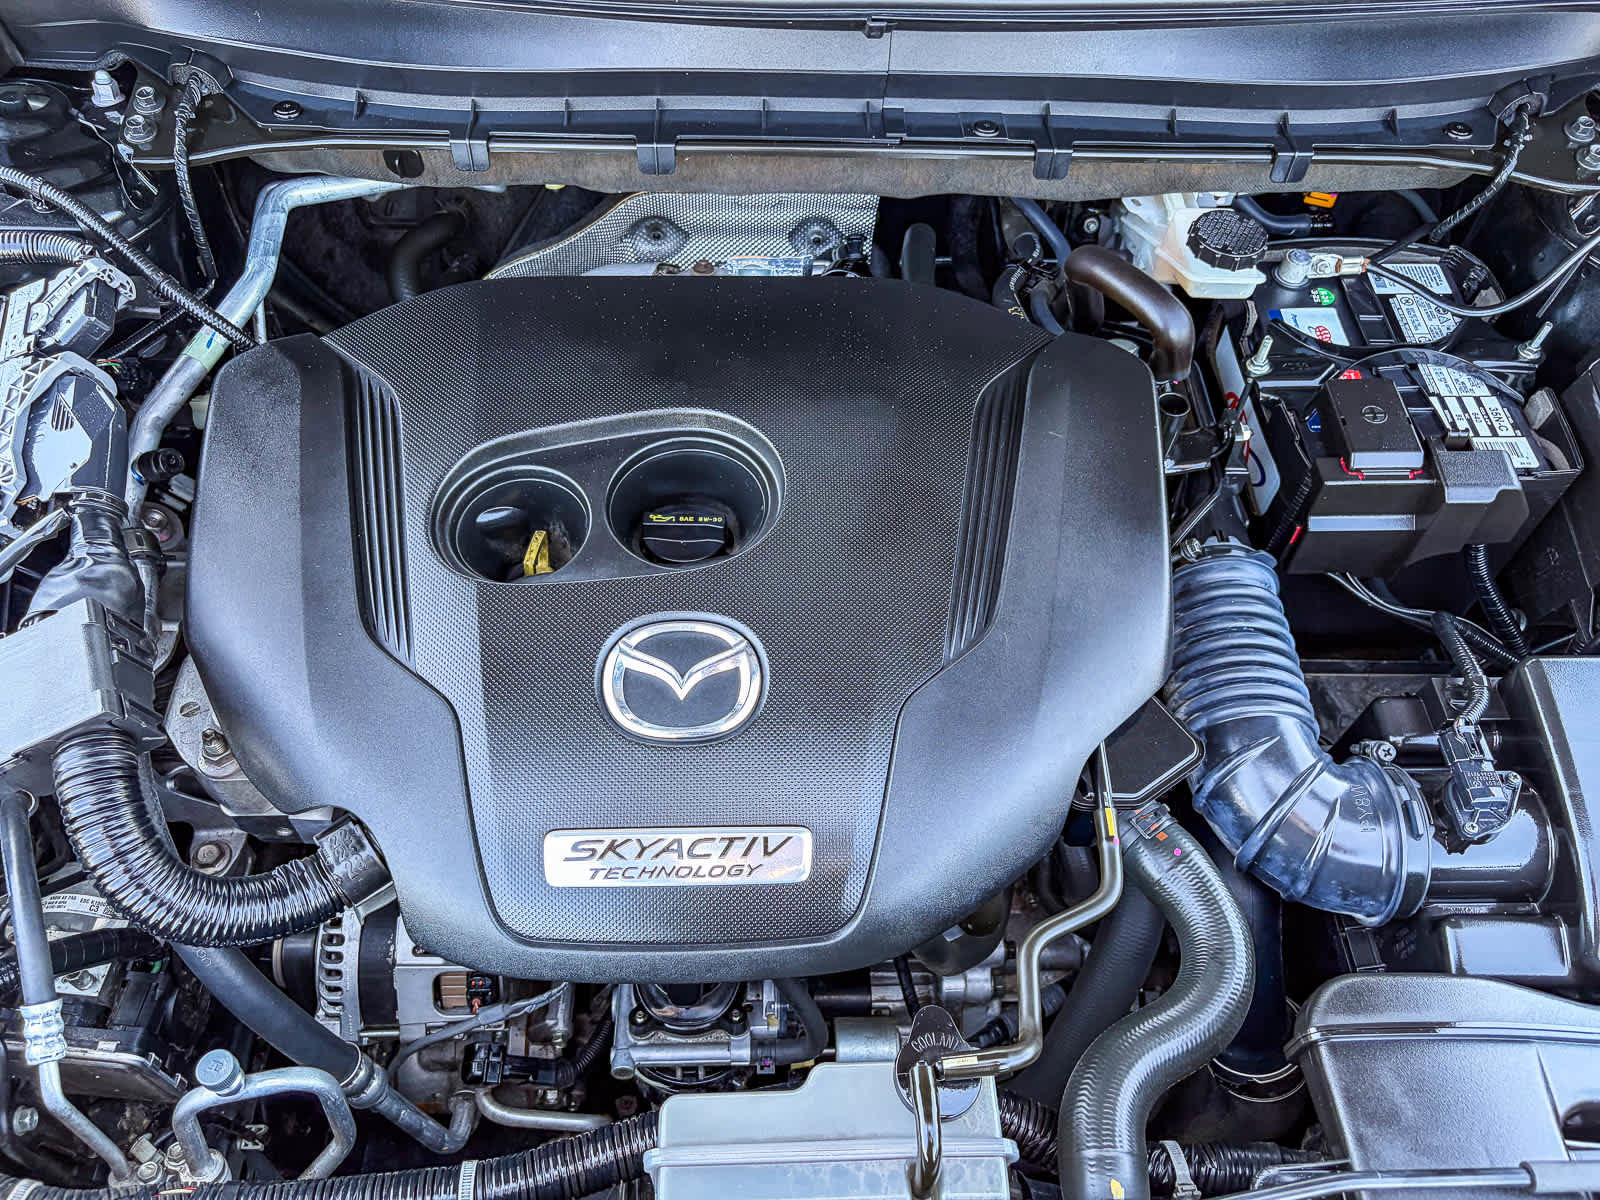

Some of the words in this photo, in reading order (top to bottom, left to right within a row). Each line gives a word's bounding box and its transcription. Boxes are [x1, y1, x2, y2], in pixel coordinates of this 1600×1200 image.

[563, 836, 794, 862] SKYACTIV
[589, 863, 764, 881] TECHNOLOGY
[911, 1031, 959, 1052] COOLANT
